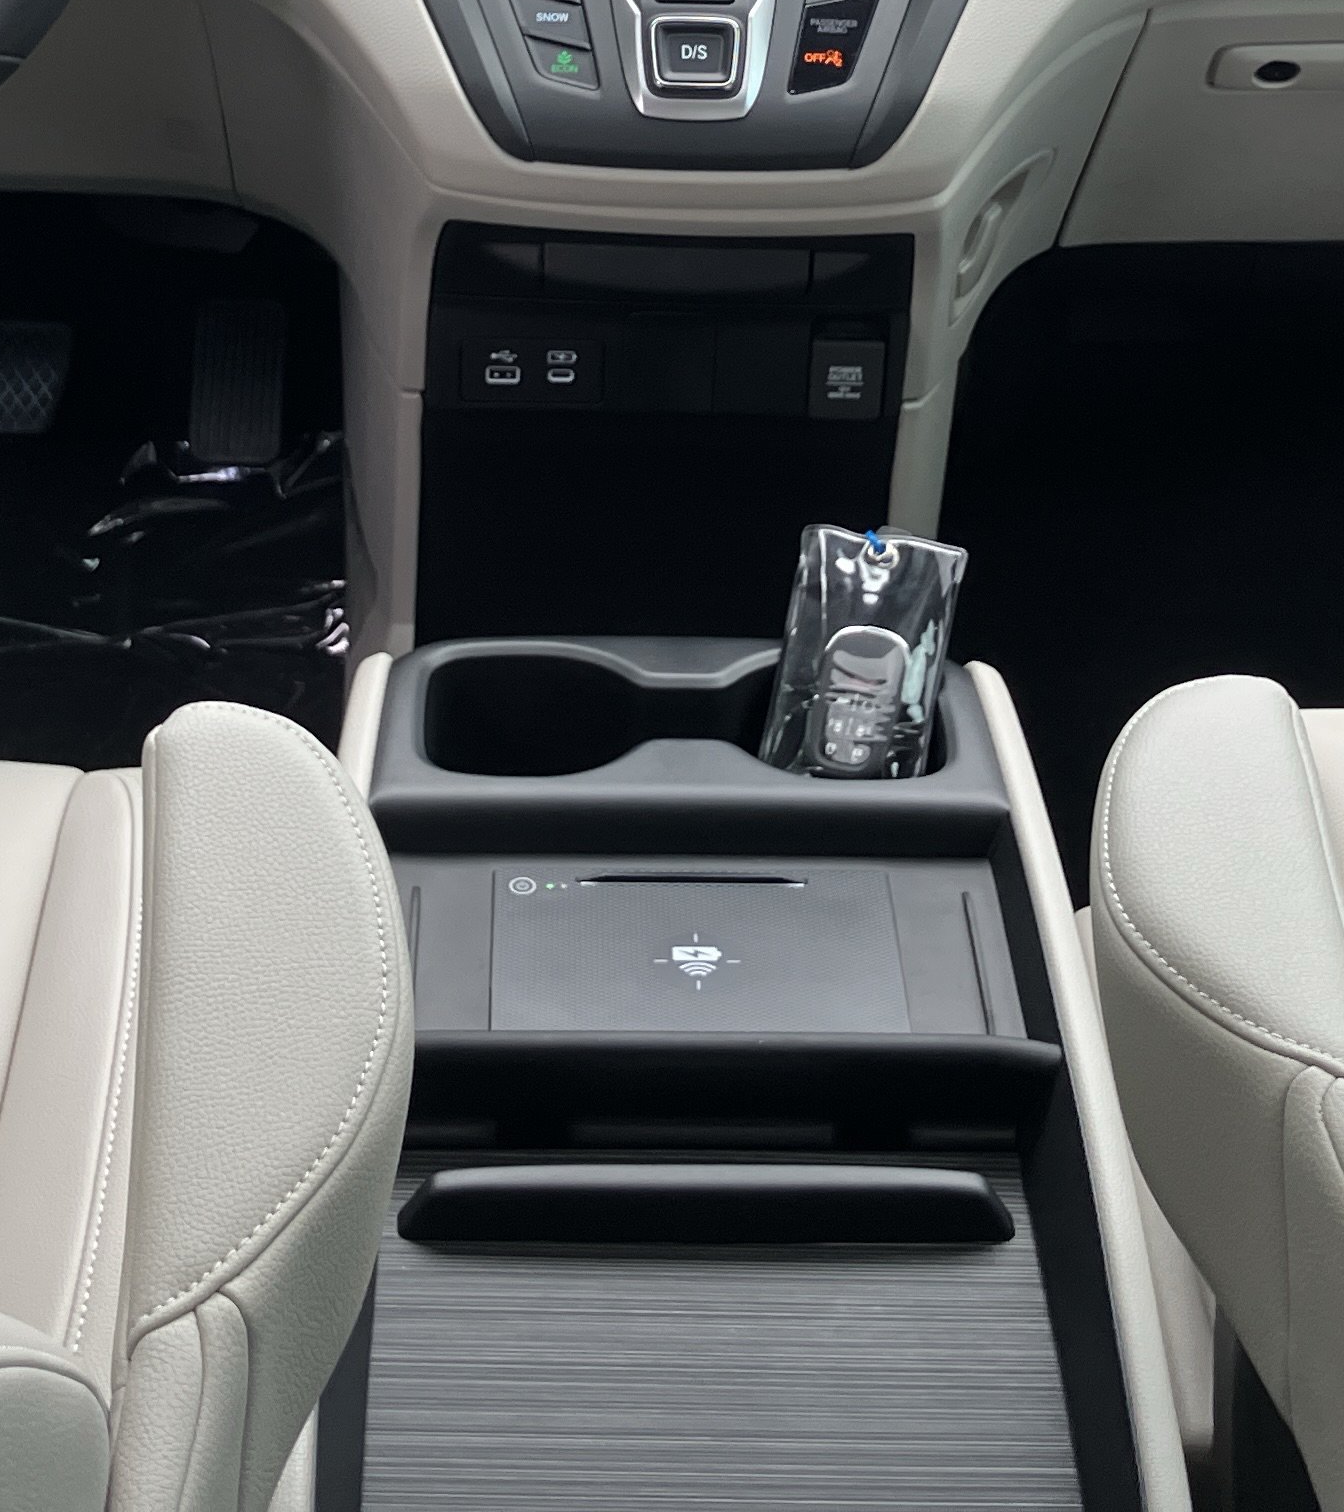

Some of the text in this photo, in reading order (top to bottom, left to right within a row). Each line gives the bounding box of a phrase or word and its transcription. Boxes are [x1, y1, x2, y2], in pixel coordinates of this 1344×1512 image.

[535, 12, 569, 23] SNOW
[681, 43, 708, 60] D/S
[804, 52, 826, 64] OFF
[551, 63, 579, 73] ECON
